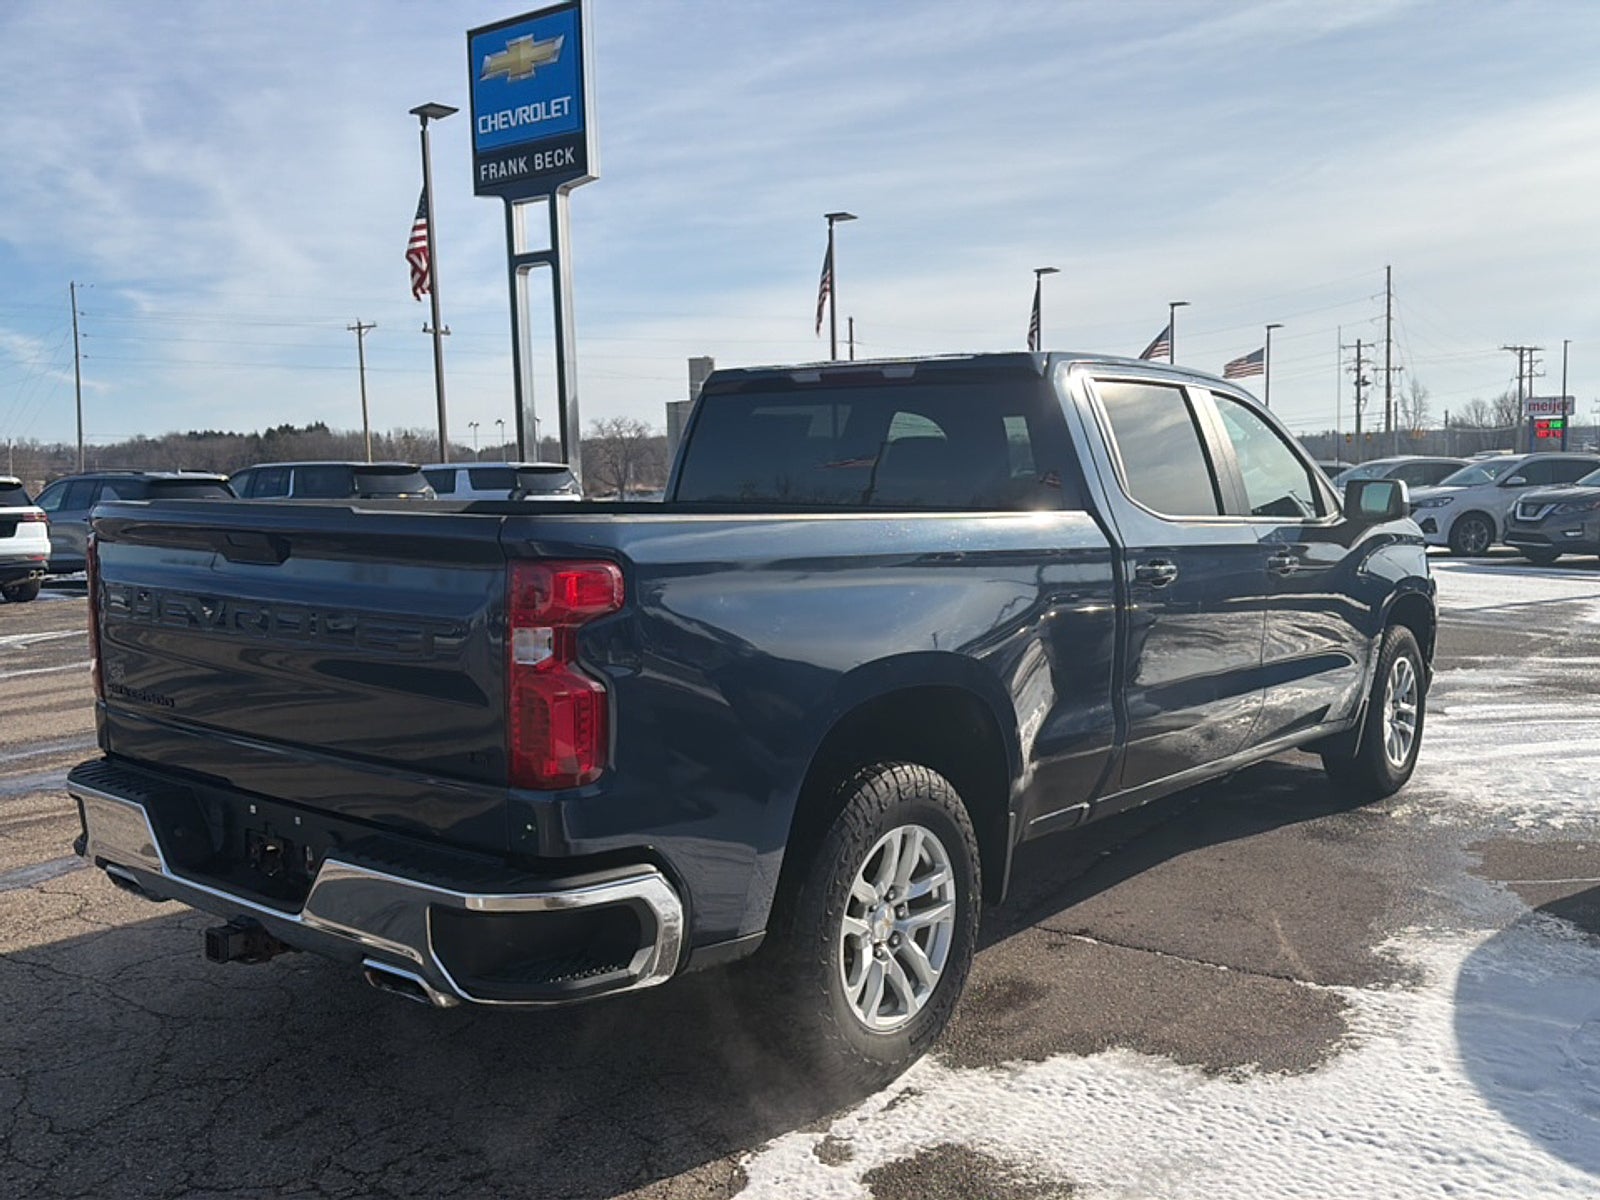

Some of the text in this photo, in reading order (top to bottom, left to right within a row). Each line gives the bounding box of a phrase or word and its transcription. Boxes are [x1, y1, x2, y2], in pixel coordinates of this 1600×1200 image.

[478, 96, 571, 134] CHEVROLET
[480, 147, 575, 181] FRANK BECK
[105, 586, 470, 657] CHEVROLET
